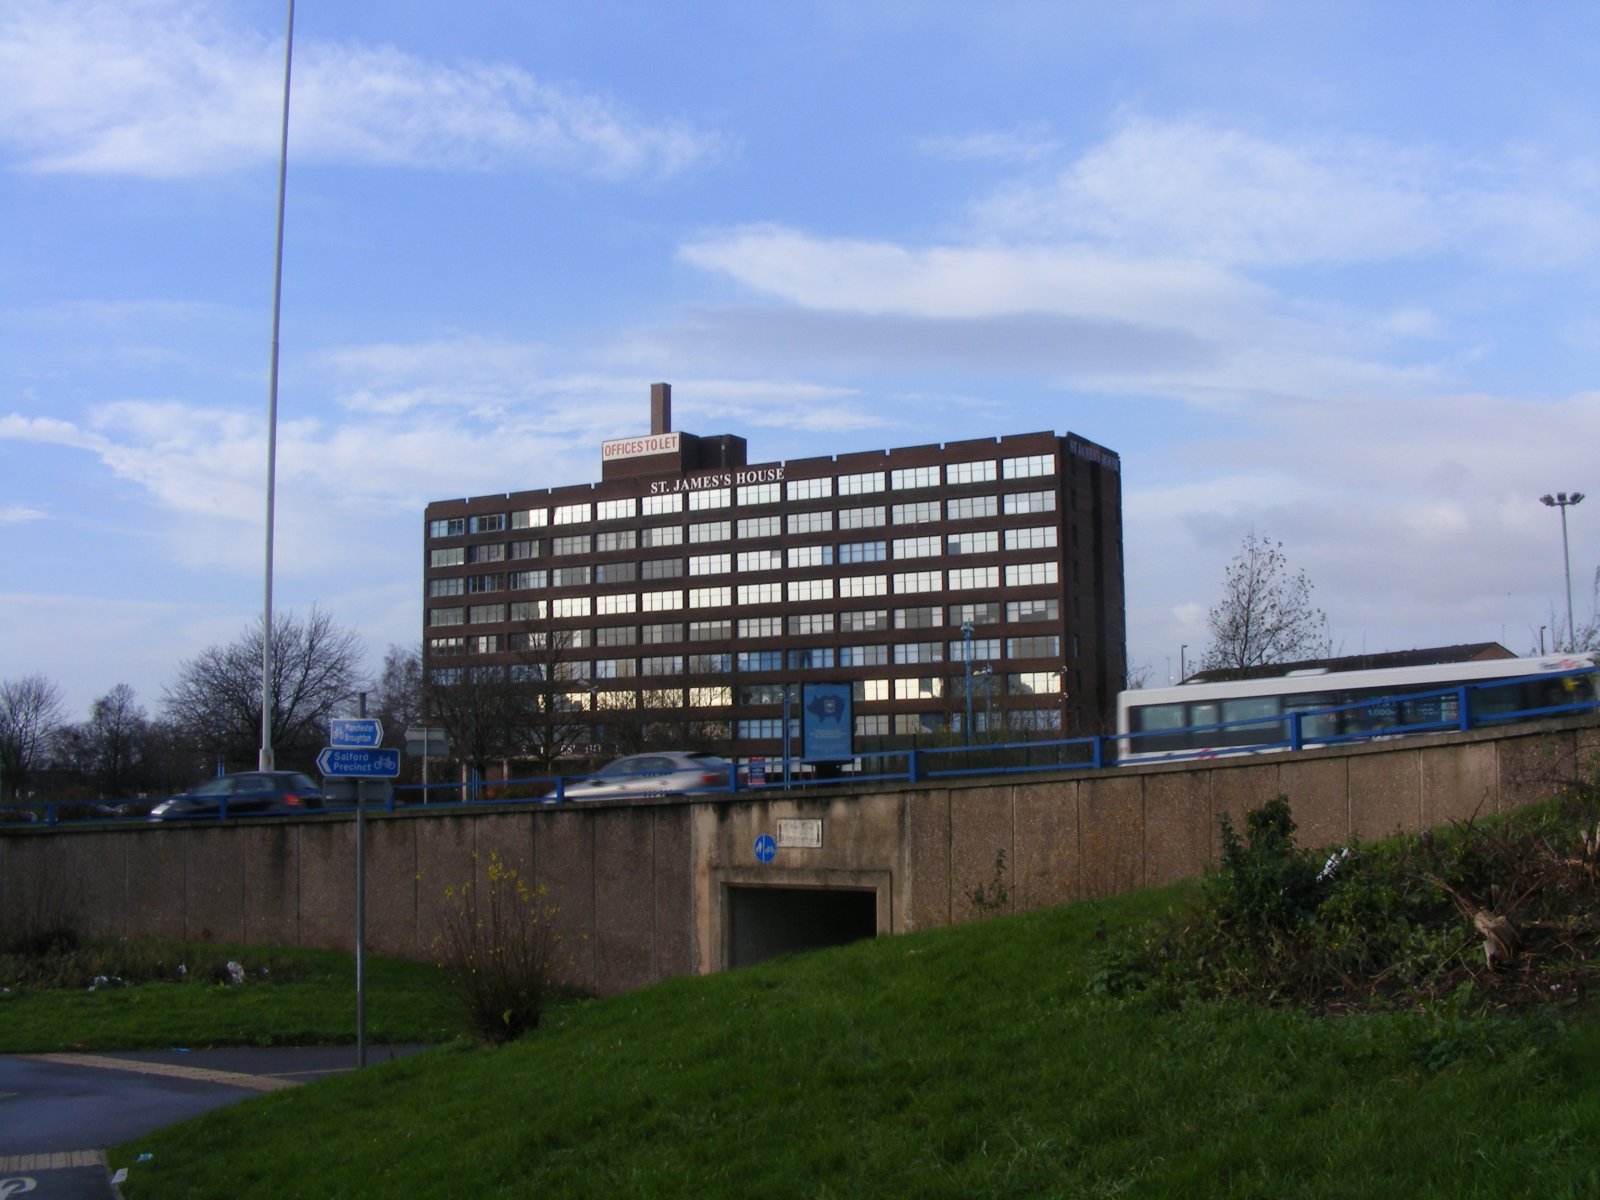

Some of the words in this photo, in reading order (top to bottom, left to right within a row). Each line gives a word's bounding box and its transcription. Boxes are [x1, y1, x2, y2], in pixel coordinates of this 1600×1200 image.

[605, 441, 643, 457] OFFICES
[646, 439, 658, 452] TO
[659, 436, 677, 449] LET
[650, 480, 669, 493] ST.
[673, 475, 731, 491] JAMES'S
[736, 468, 785, 485] HOUSE
[345, 724, 374, 732] Manchester
[345, 734, 371, 744] Broughton
[334, 752, 369, 761] Salford
[333, 761, 371, 771] Precinct
